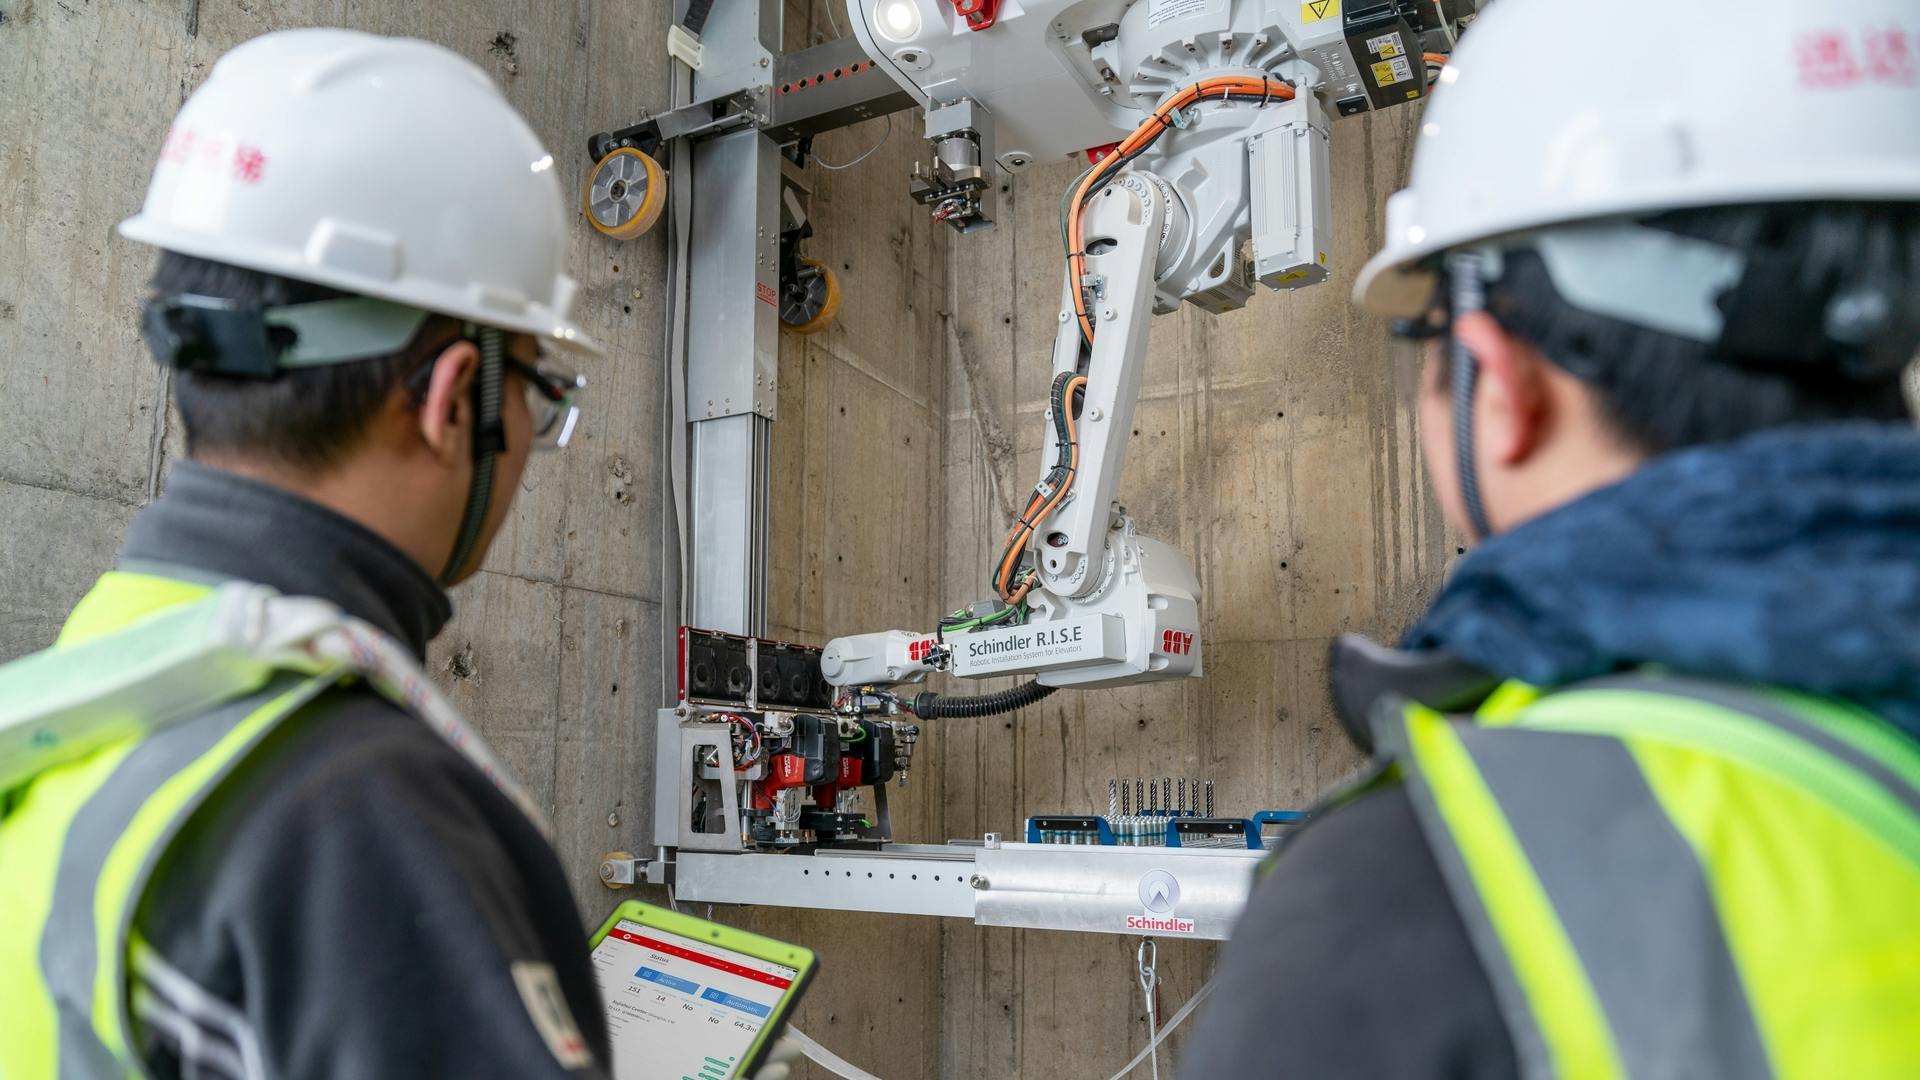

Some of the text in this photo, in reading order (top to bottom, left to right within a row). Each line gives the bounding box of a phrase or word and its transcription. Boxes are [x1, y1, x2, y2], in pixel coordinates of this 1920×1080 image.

[757, 282, 776, 298] STOP
[969, 626, 1082, 657] Schindler R.I.S.E
[1163, 629, 1193, 656] ABB
[970, 645, 1082, 668] Robotic Installation System for Elevators
[1127, 917, 1193, 931] Schindler
[650, 953, 669, 963] Status
[628, 985, 641, 993] 151
[682, 1003, 693, 1011] No
[726, 999, 760, 1014] Automatic
[708, 1016, 720, 1024] No
